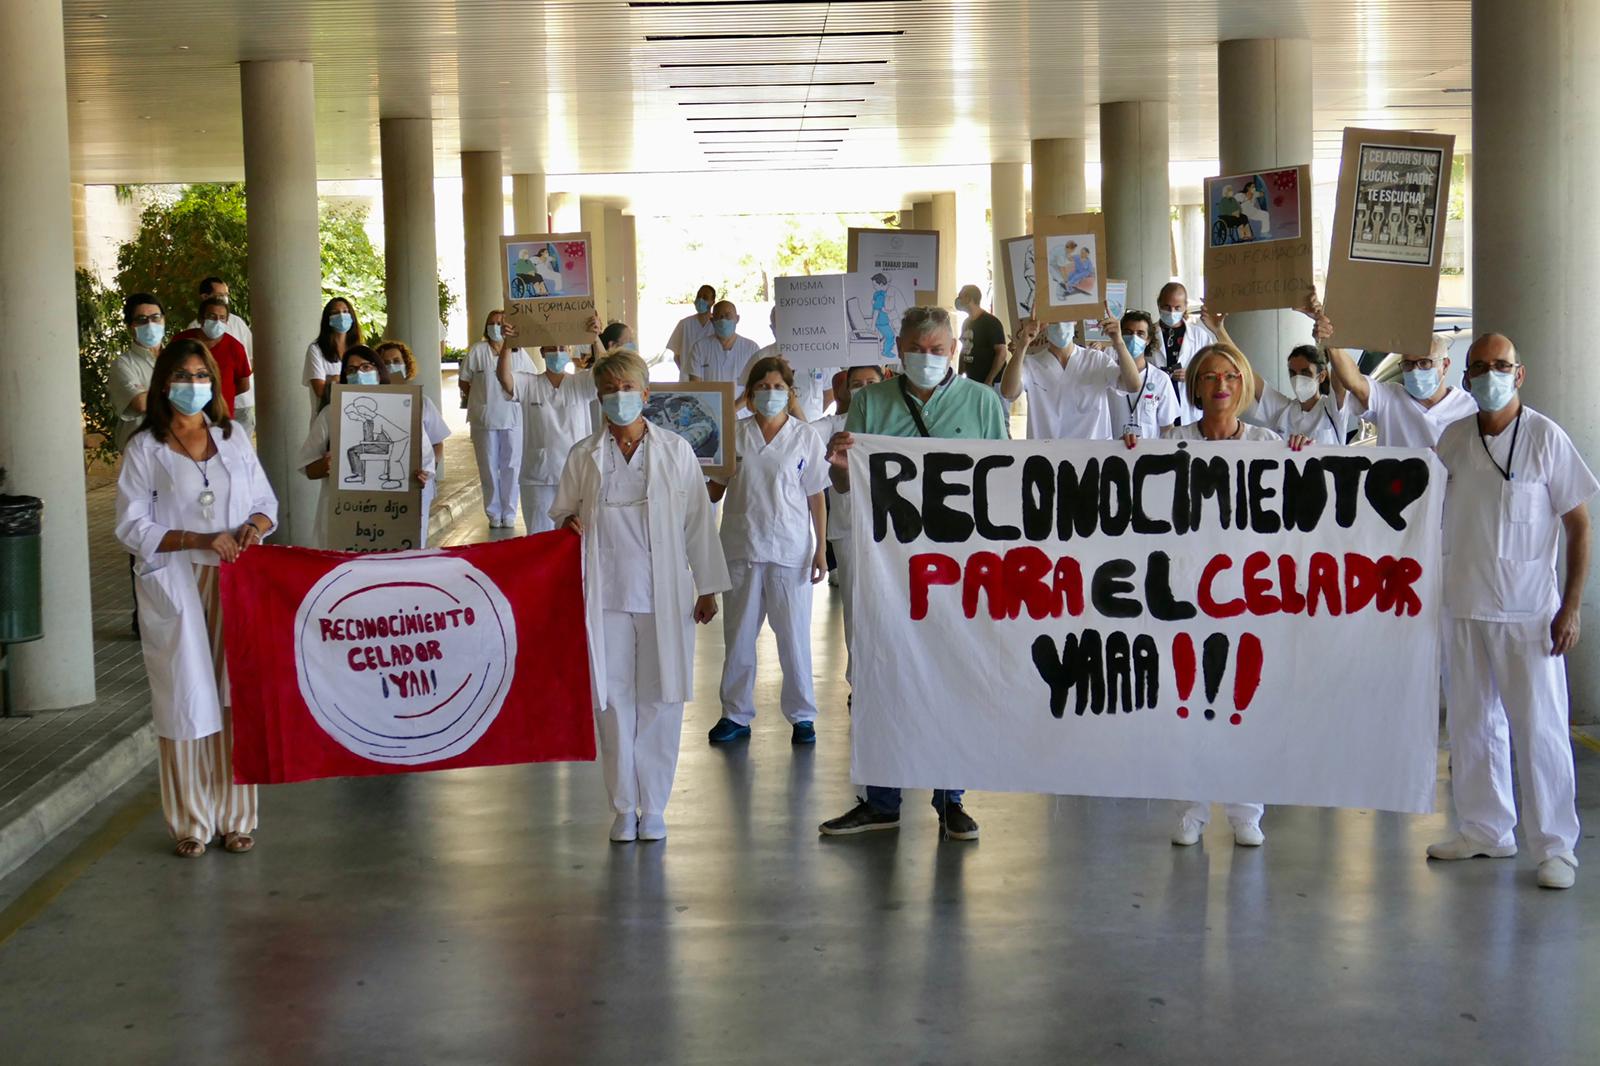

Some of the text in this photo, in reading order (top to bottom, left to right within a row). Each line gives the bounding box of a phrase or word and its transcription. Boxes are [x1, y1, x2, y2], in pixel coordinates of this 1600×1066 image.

[1412, 153, 1422, 166] SI
[1423, 154, 1438, 167] NO
[1406, 172, 1434, 186] NADIE
[1367, 189, 1426, 205] TE ESCUCHA!
[789, 281, 824, 291] MISMA
[511, 303, 533, 315] SIN
[792, 326, 827, 336] MISMA
[384, 500, 408, 519] dijo
[355, 521, 385, 542] bajo
[908, 545, 1423, 622] PARA EL CELADOR
[318, 605, 475, 642] RECONOCIMIENTO
[347, 640, 443, 672] CELADOR
